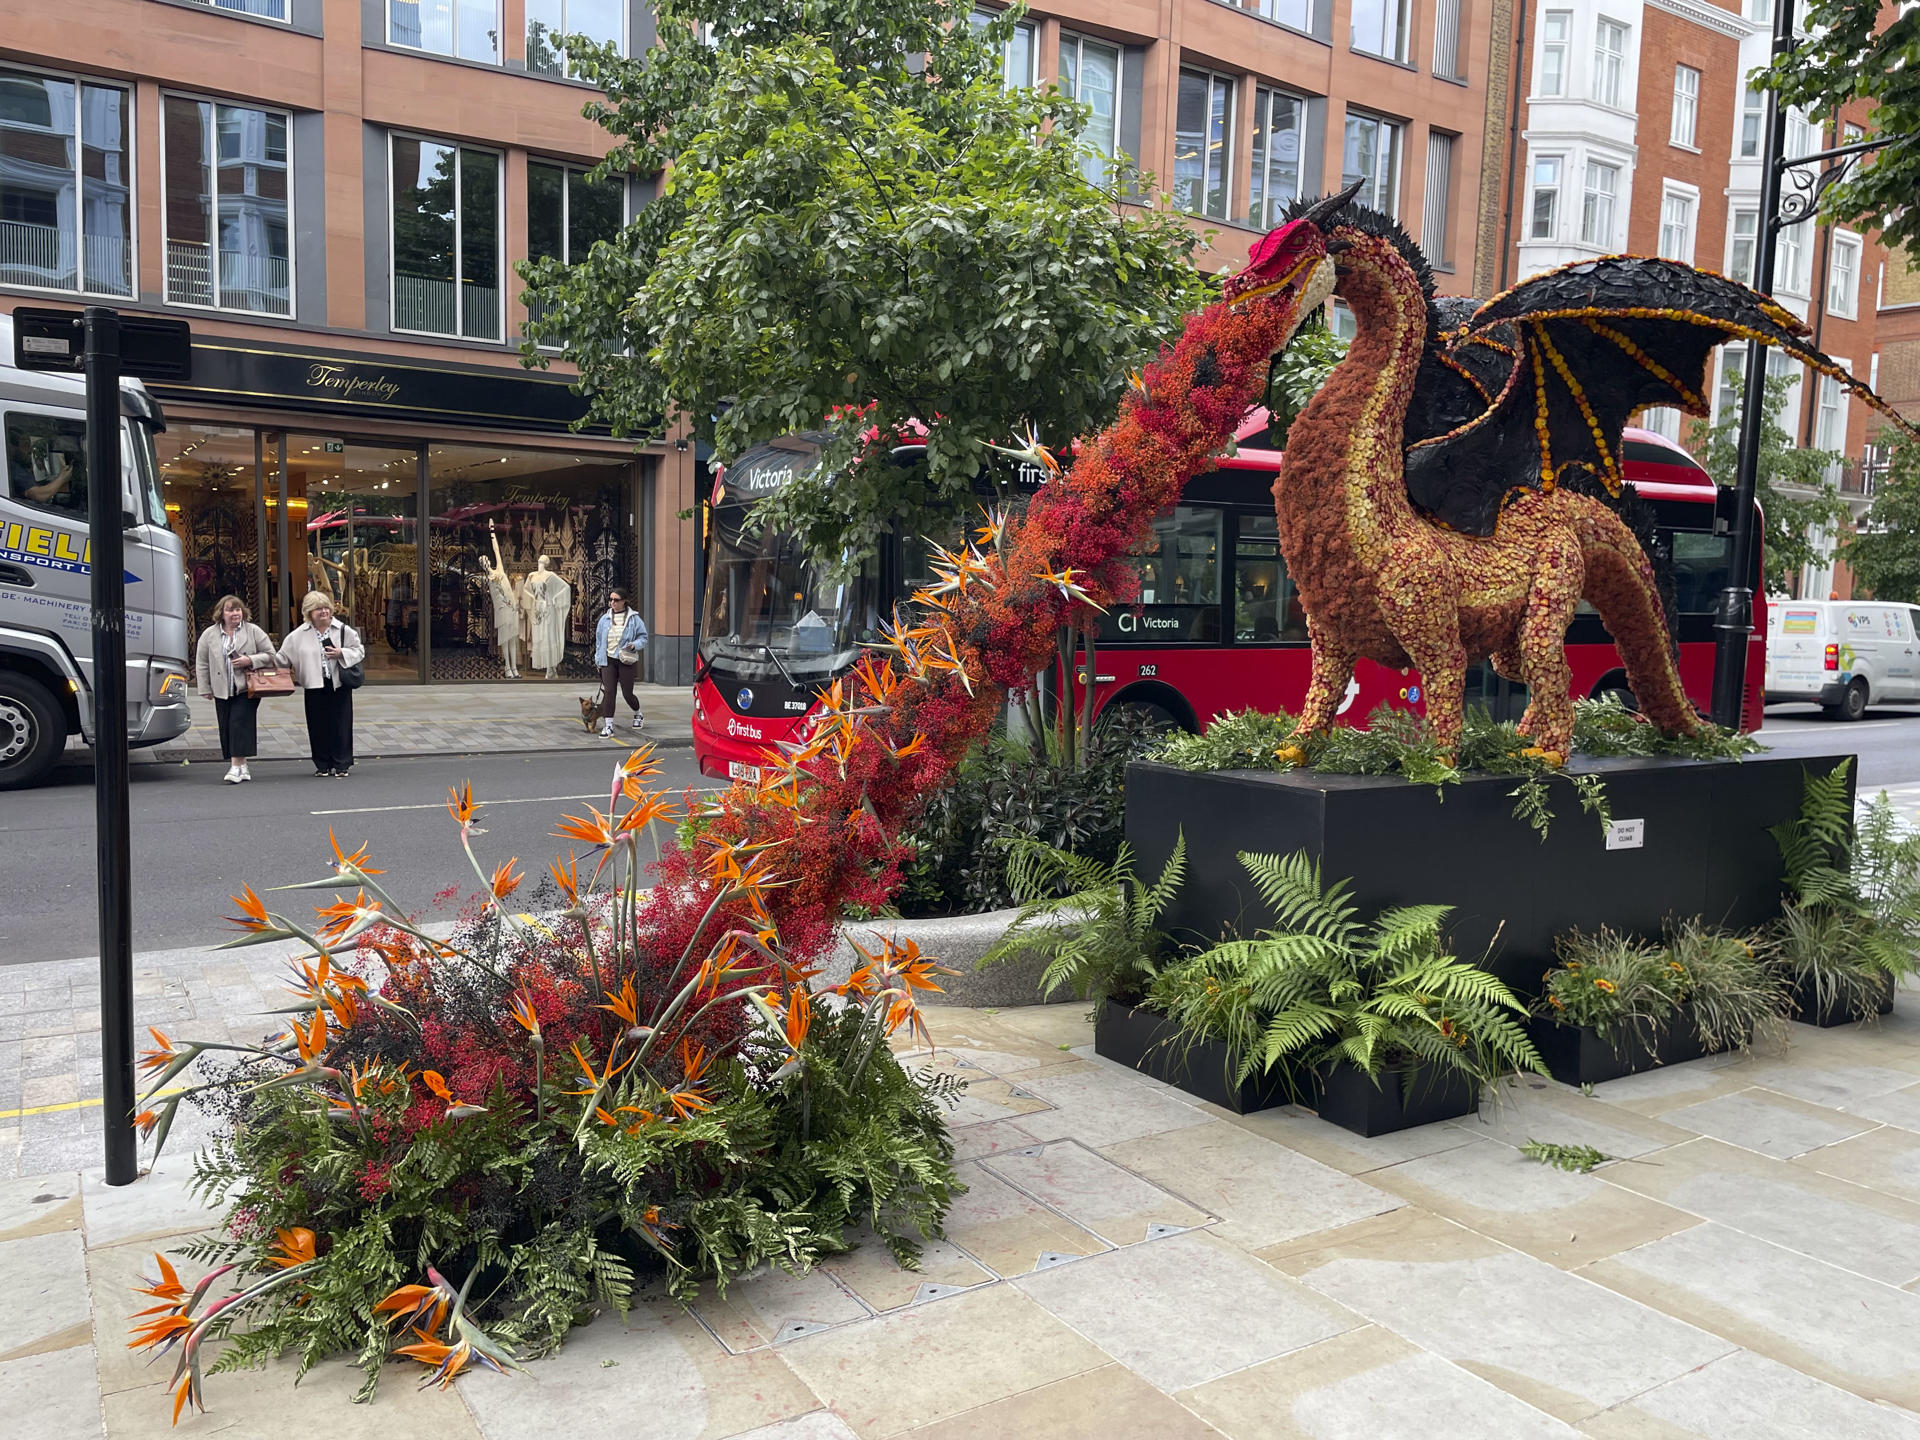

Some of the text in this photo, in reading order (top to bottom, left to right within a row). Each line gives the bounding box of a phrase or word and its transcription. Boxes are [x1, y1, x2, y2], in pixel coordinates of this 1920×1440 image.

[306, 363, 399, 401] Temperley
[749, 464, 792, 490] Victoria
[501, 483, 570, 512] Temperley
[23, 596, 86, 612] MACHINERY
[1142, 617, 1179, 628] Victoria
[1857, 616, 1871, 625] VPS
[1140, 665, 1156, 676] 262
